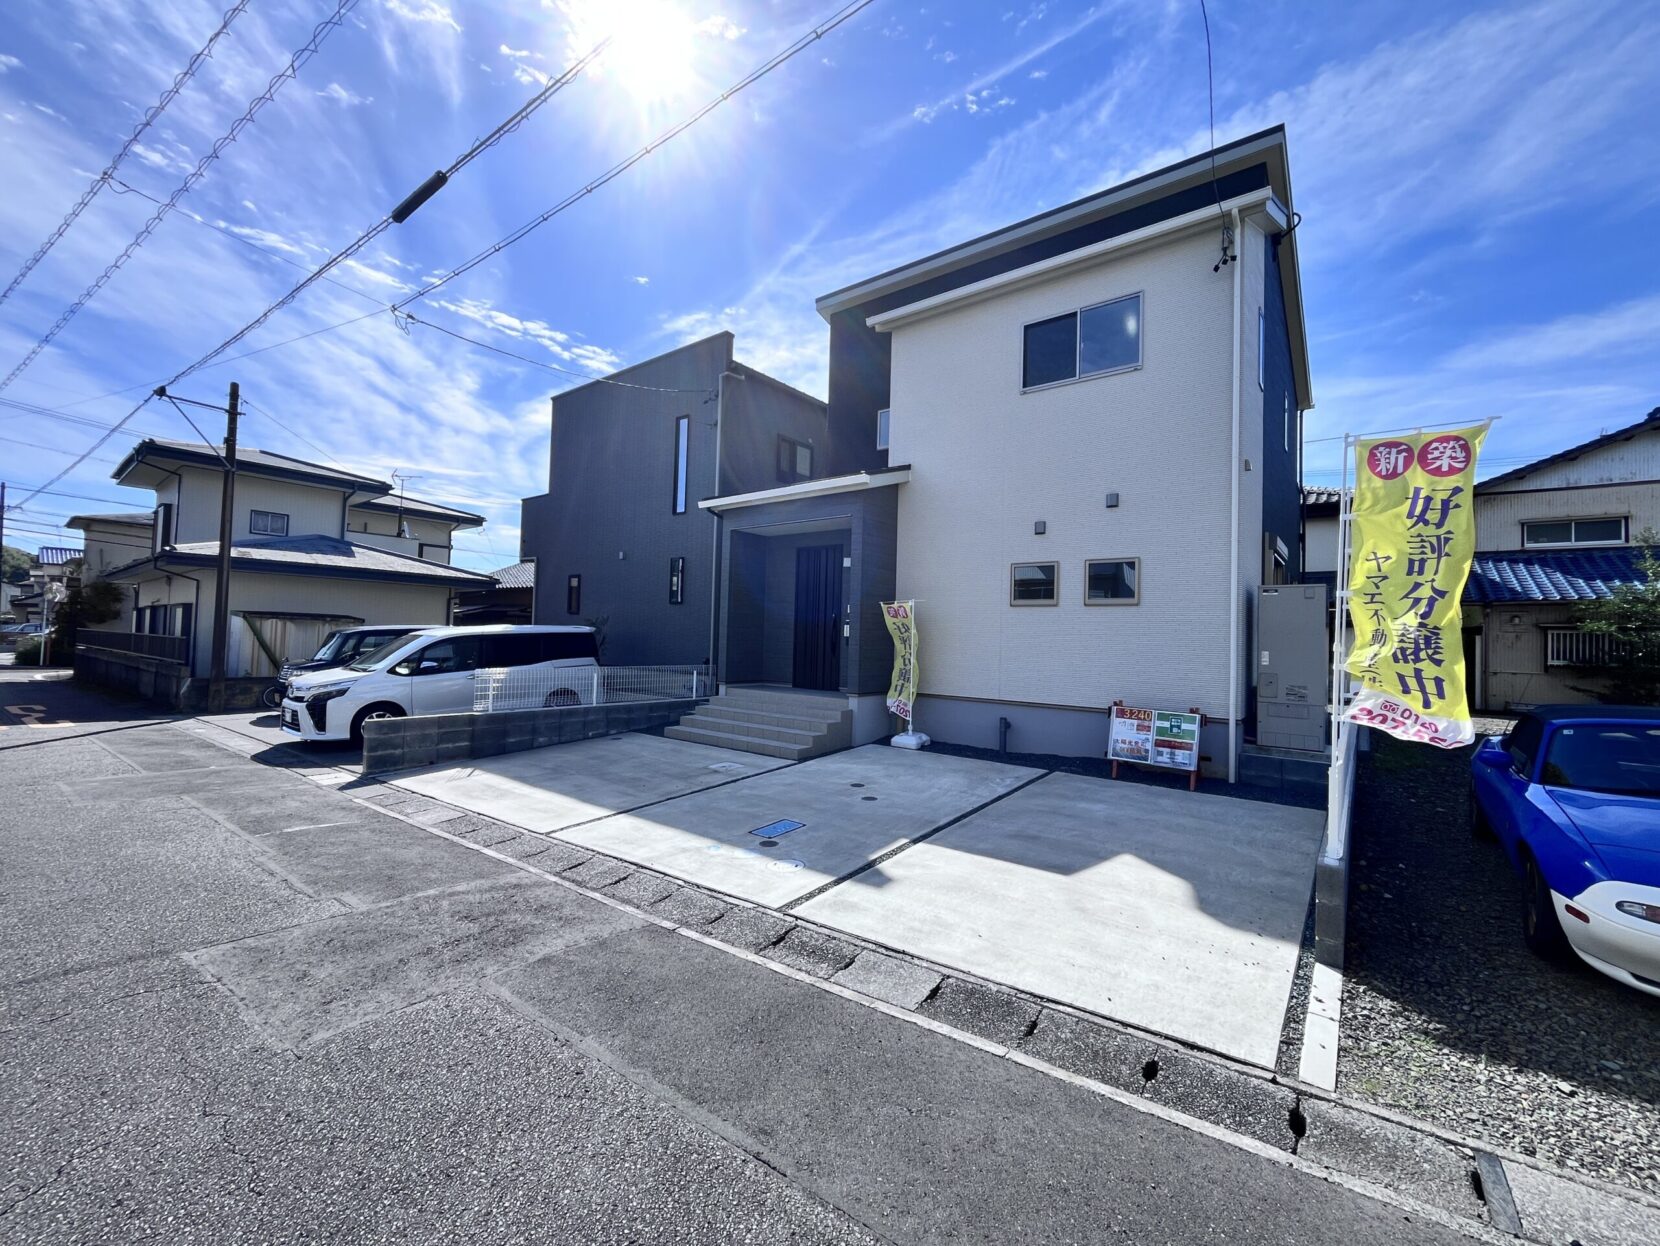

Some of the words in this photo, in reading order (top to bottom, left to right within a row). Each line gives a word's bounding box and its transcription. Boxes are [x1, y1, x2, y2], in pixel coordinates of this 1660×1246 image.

[1373, 439, 1468, 476] 新築
[1391, 485, 1464, 709] 好評分譲中
